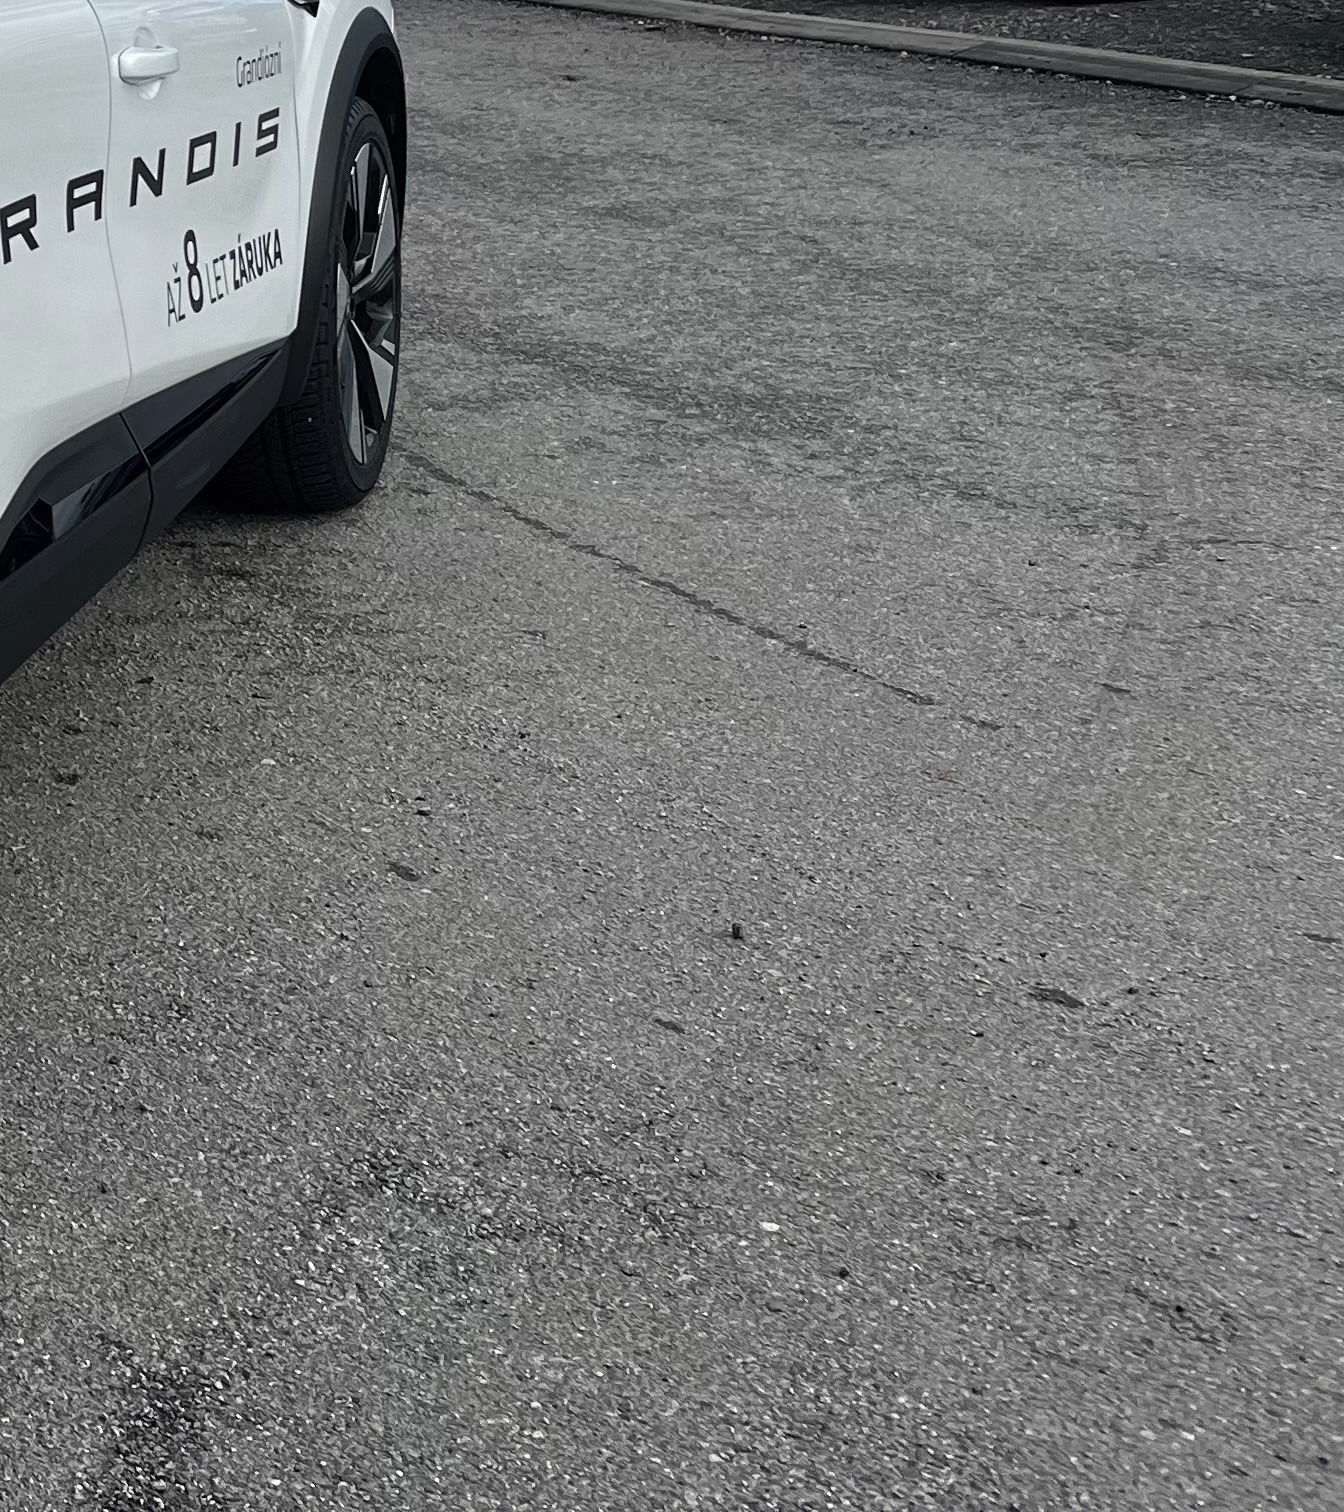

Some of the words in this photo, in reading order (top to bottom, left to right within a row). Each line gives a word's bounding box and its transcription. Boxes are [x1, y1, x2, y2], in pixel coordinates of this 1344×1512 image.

[167, 262, 186, 327] AŽ
[184, 229, 203, 313] 8
[205, 253, 229, 304] LET
[229, 228, 283, 291] ZÁRUKA
